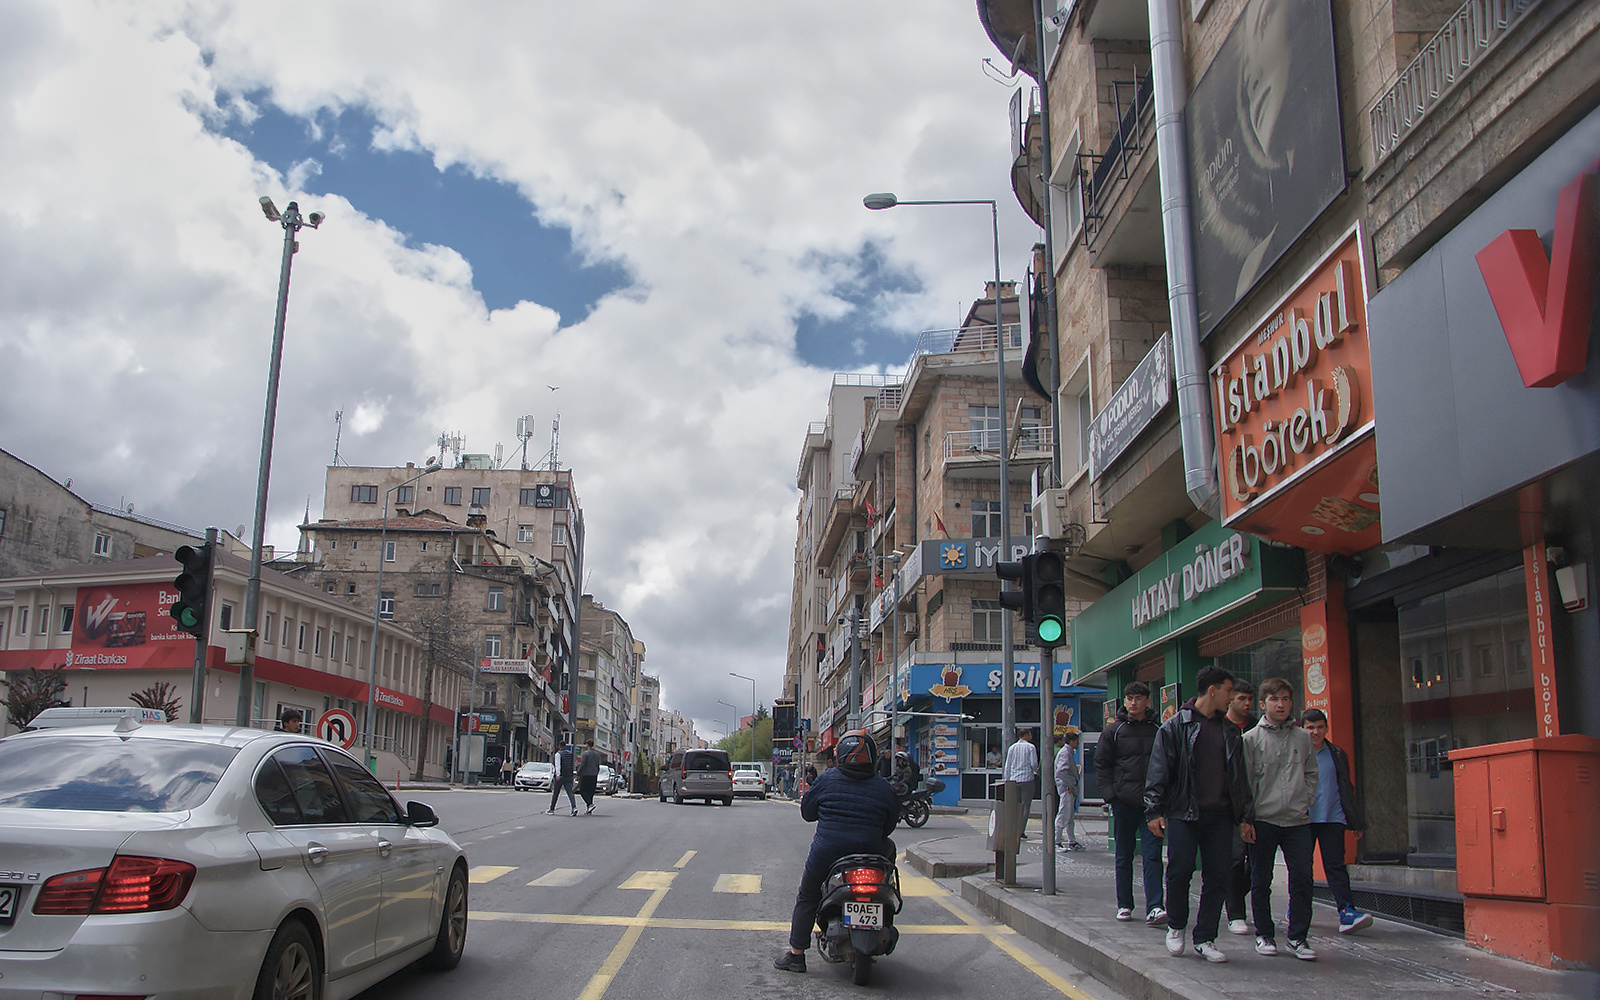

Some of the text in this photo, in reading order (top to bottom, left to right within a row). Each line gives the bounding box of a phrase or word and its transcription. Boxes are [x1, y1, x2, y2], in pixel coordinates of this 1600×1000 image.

[1257, 311, 1284, 346] MEŞHUR
[1216, 260, 1351, 434] İstanbul
[1241, 378, 1328, 488] börek
[1131, 532, 1246, 629] HATAY DÖNER
[74, 653, 127, 665] Ziraat Bankası
[141, 710, 161, 721] HAS
[846, 903, 880, 914] 50AET
[858, 915, 878, 925] 473
